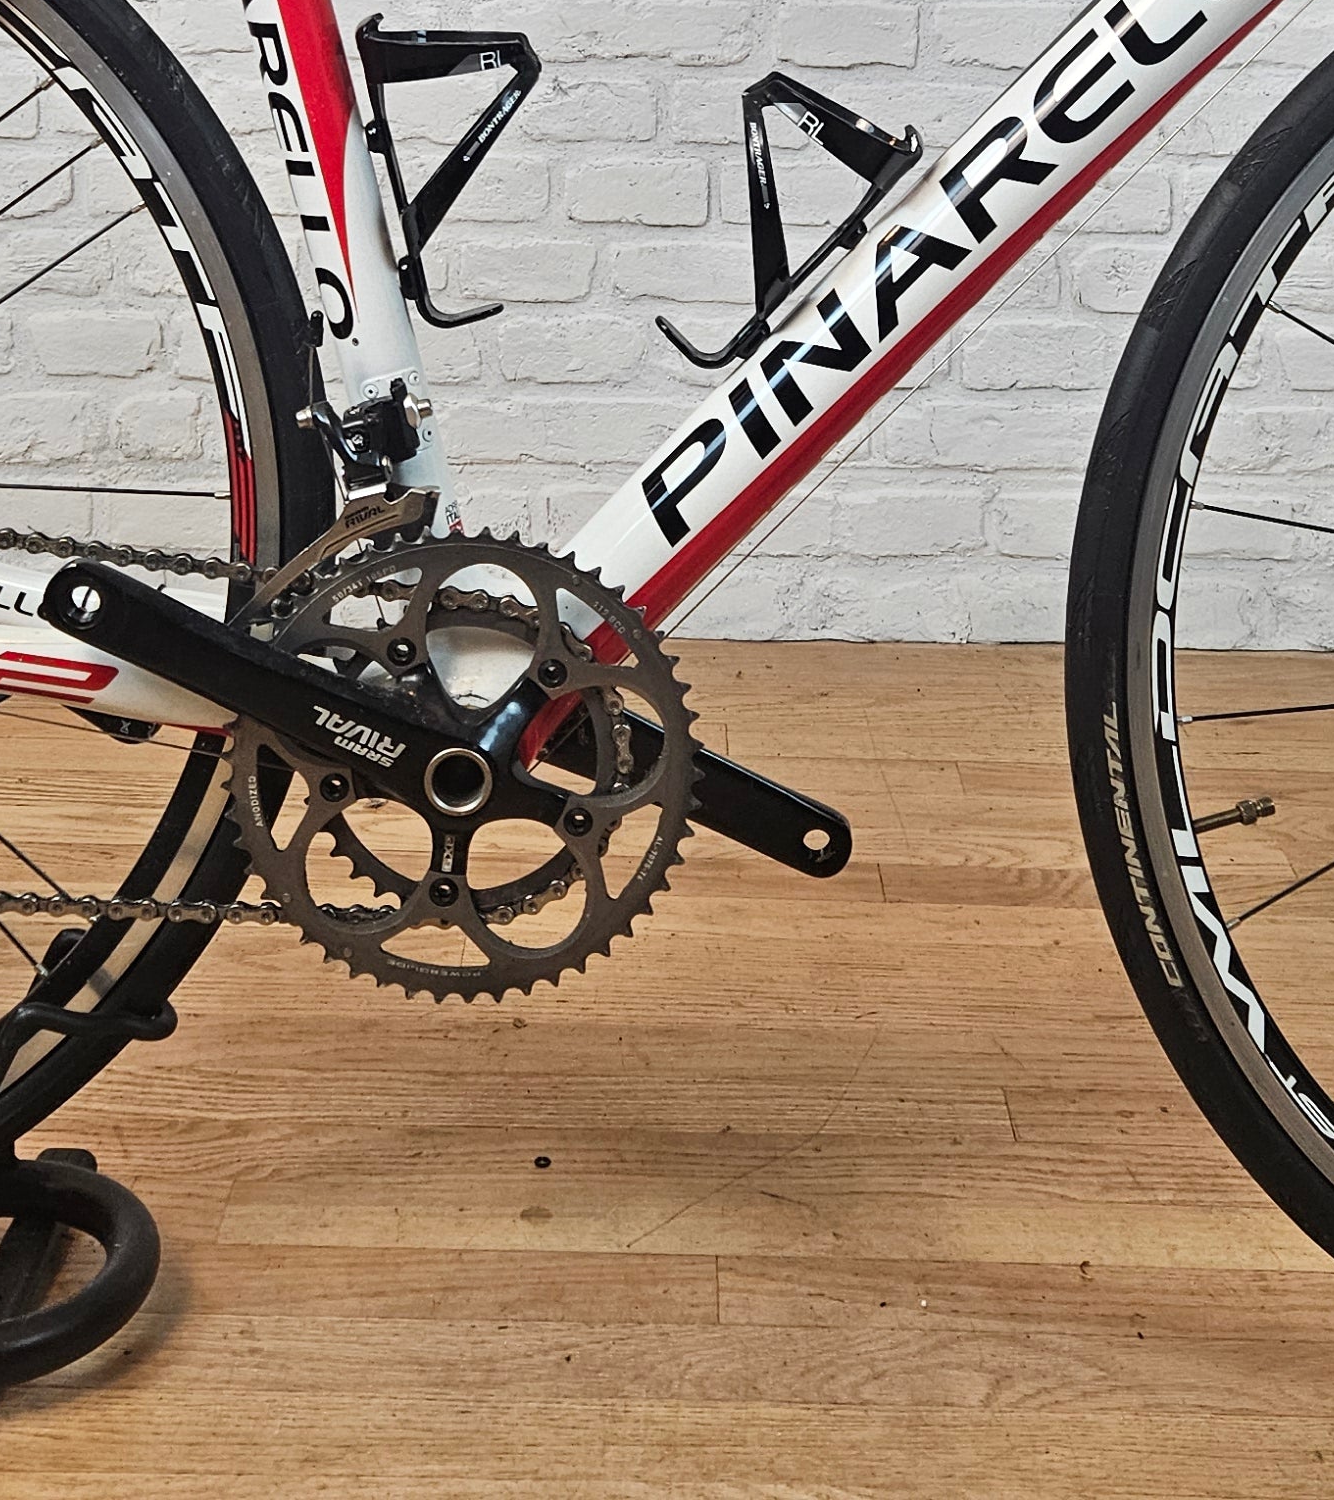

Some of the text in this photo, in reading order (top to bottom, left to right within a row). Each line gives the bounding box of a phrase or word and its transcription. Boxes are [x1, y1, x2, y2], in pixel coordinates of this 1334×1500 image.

[477, 90, 522, 144] BONTRAGER
[796, 110, 825, 146] RL
[749, 122, 767, 186] BONTRAGER
[345, 506, 386, 529] RIVAL
[313, 705, 407, 759] RIVAL
[333, 735, 395, 768] SRAM
[248, 775, 264, 828] ANODIZED
[1101, 700, 1185, 990] CONTINENTAL
